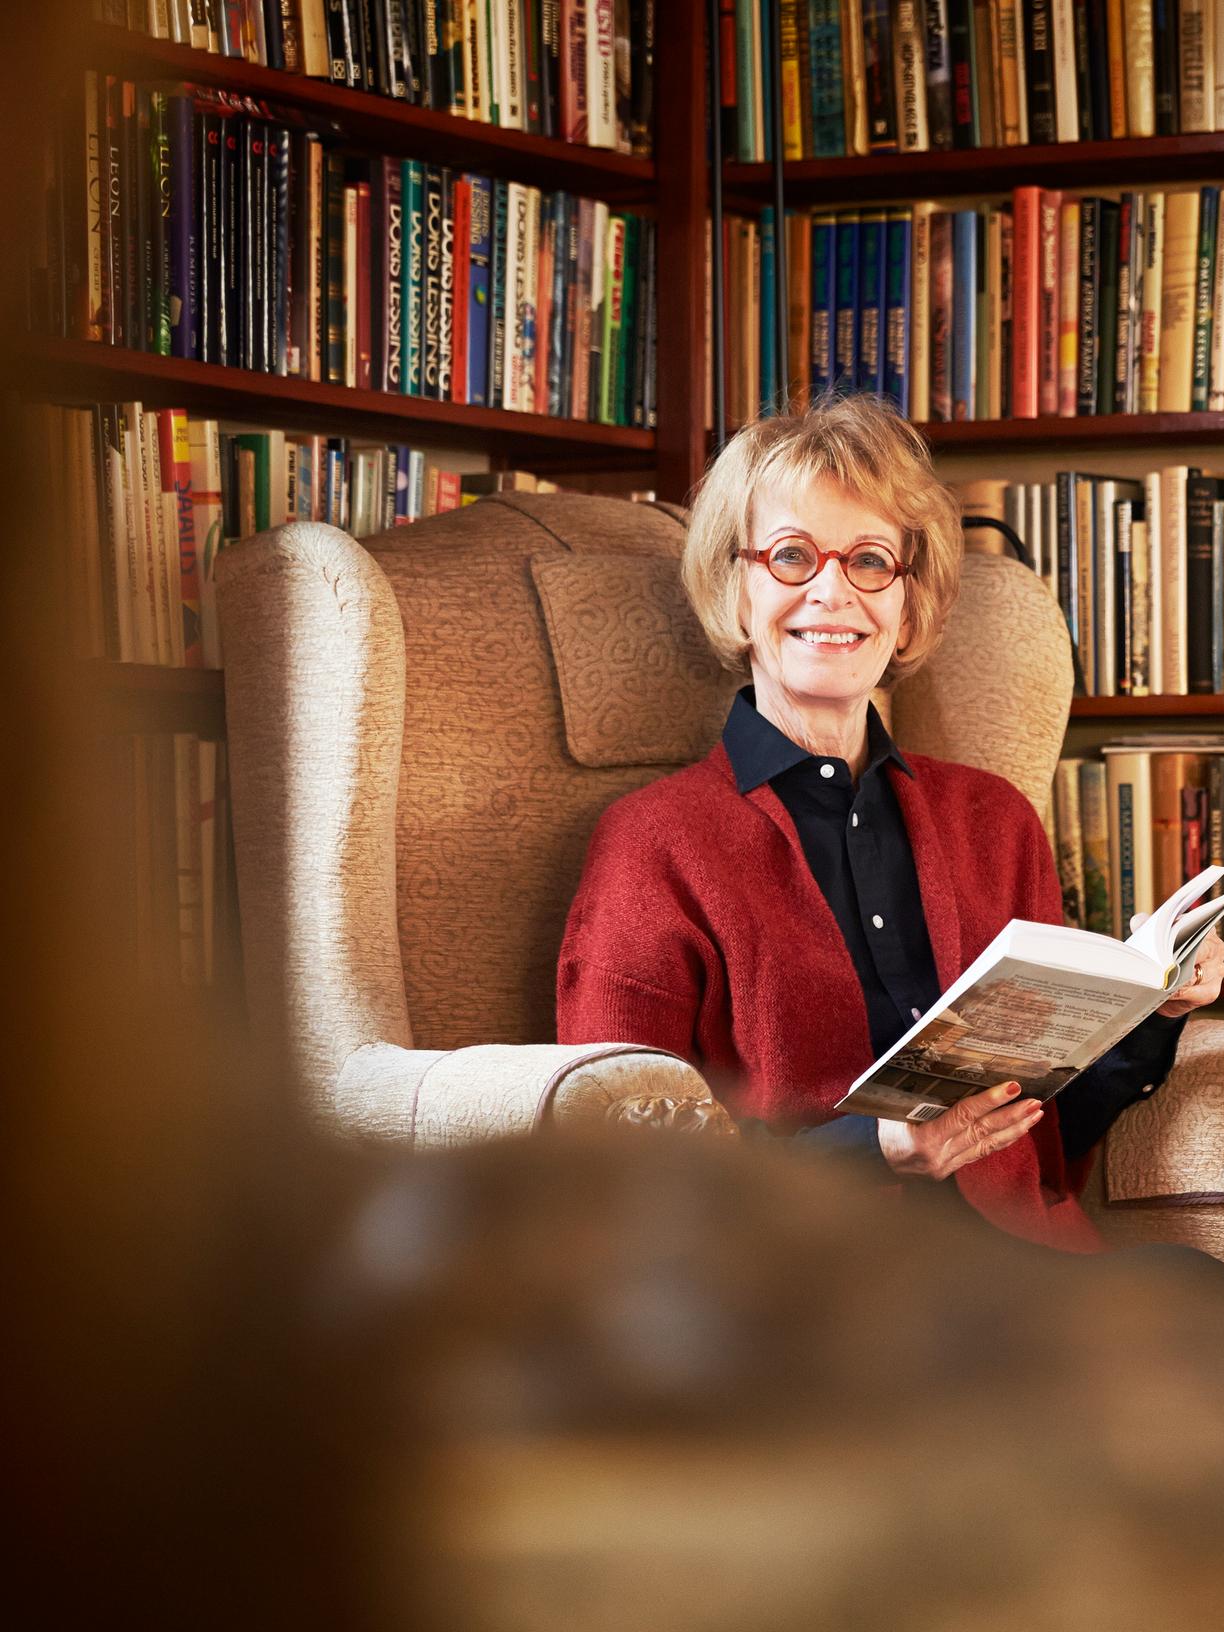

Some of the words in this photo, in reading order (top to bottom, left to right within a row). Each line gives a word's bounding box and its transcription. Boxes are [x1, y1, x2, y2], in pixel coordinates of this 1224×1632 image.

[389, 203, 401, 277] DORIS
[427, 192, 440, 271] DORIS
[441, 218, 453, 290] DORIS
[389, 281, 400, 384] LESSING
[425, 276, 440, 385] LESSING
[439, 291, 453, 391] LESSING
